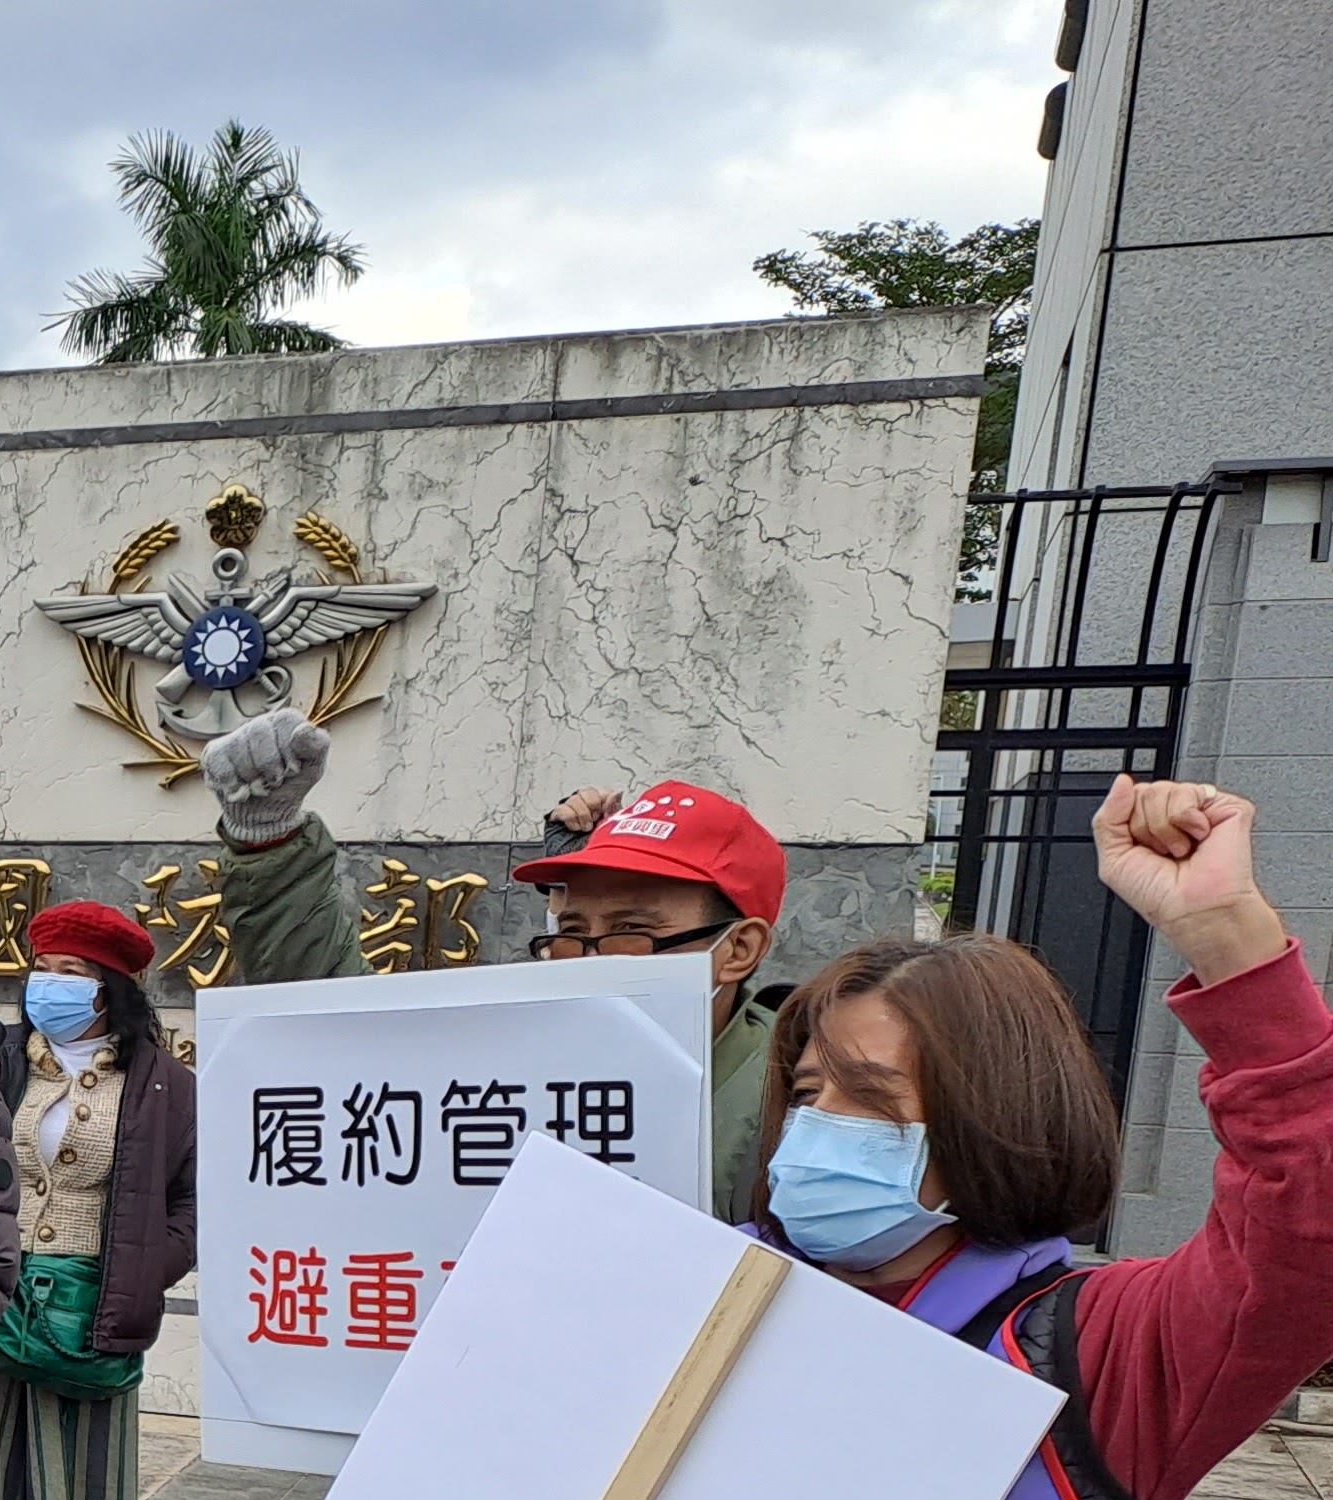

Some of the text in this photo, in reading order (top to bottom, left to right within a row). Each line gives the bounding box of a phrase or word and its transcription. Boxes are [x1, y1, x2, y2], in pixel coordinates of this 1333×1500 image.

[249, 1078, 636, 1187] 履約管理
[247, 1246, 458, 1351] 避重
